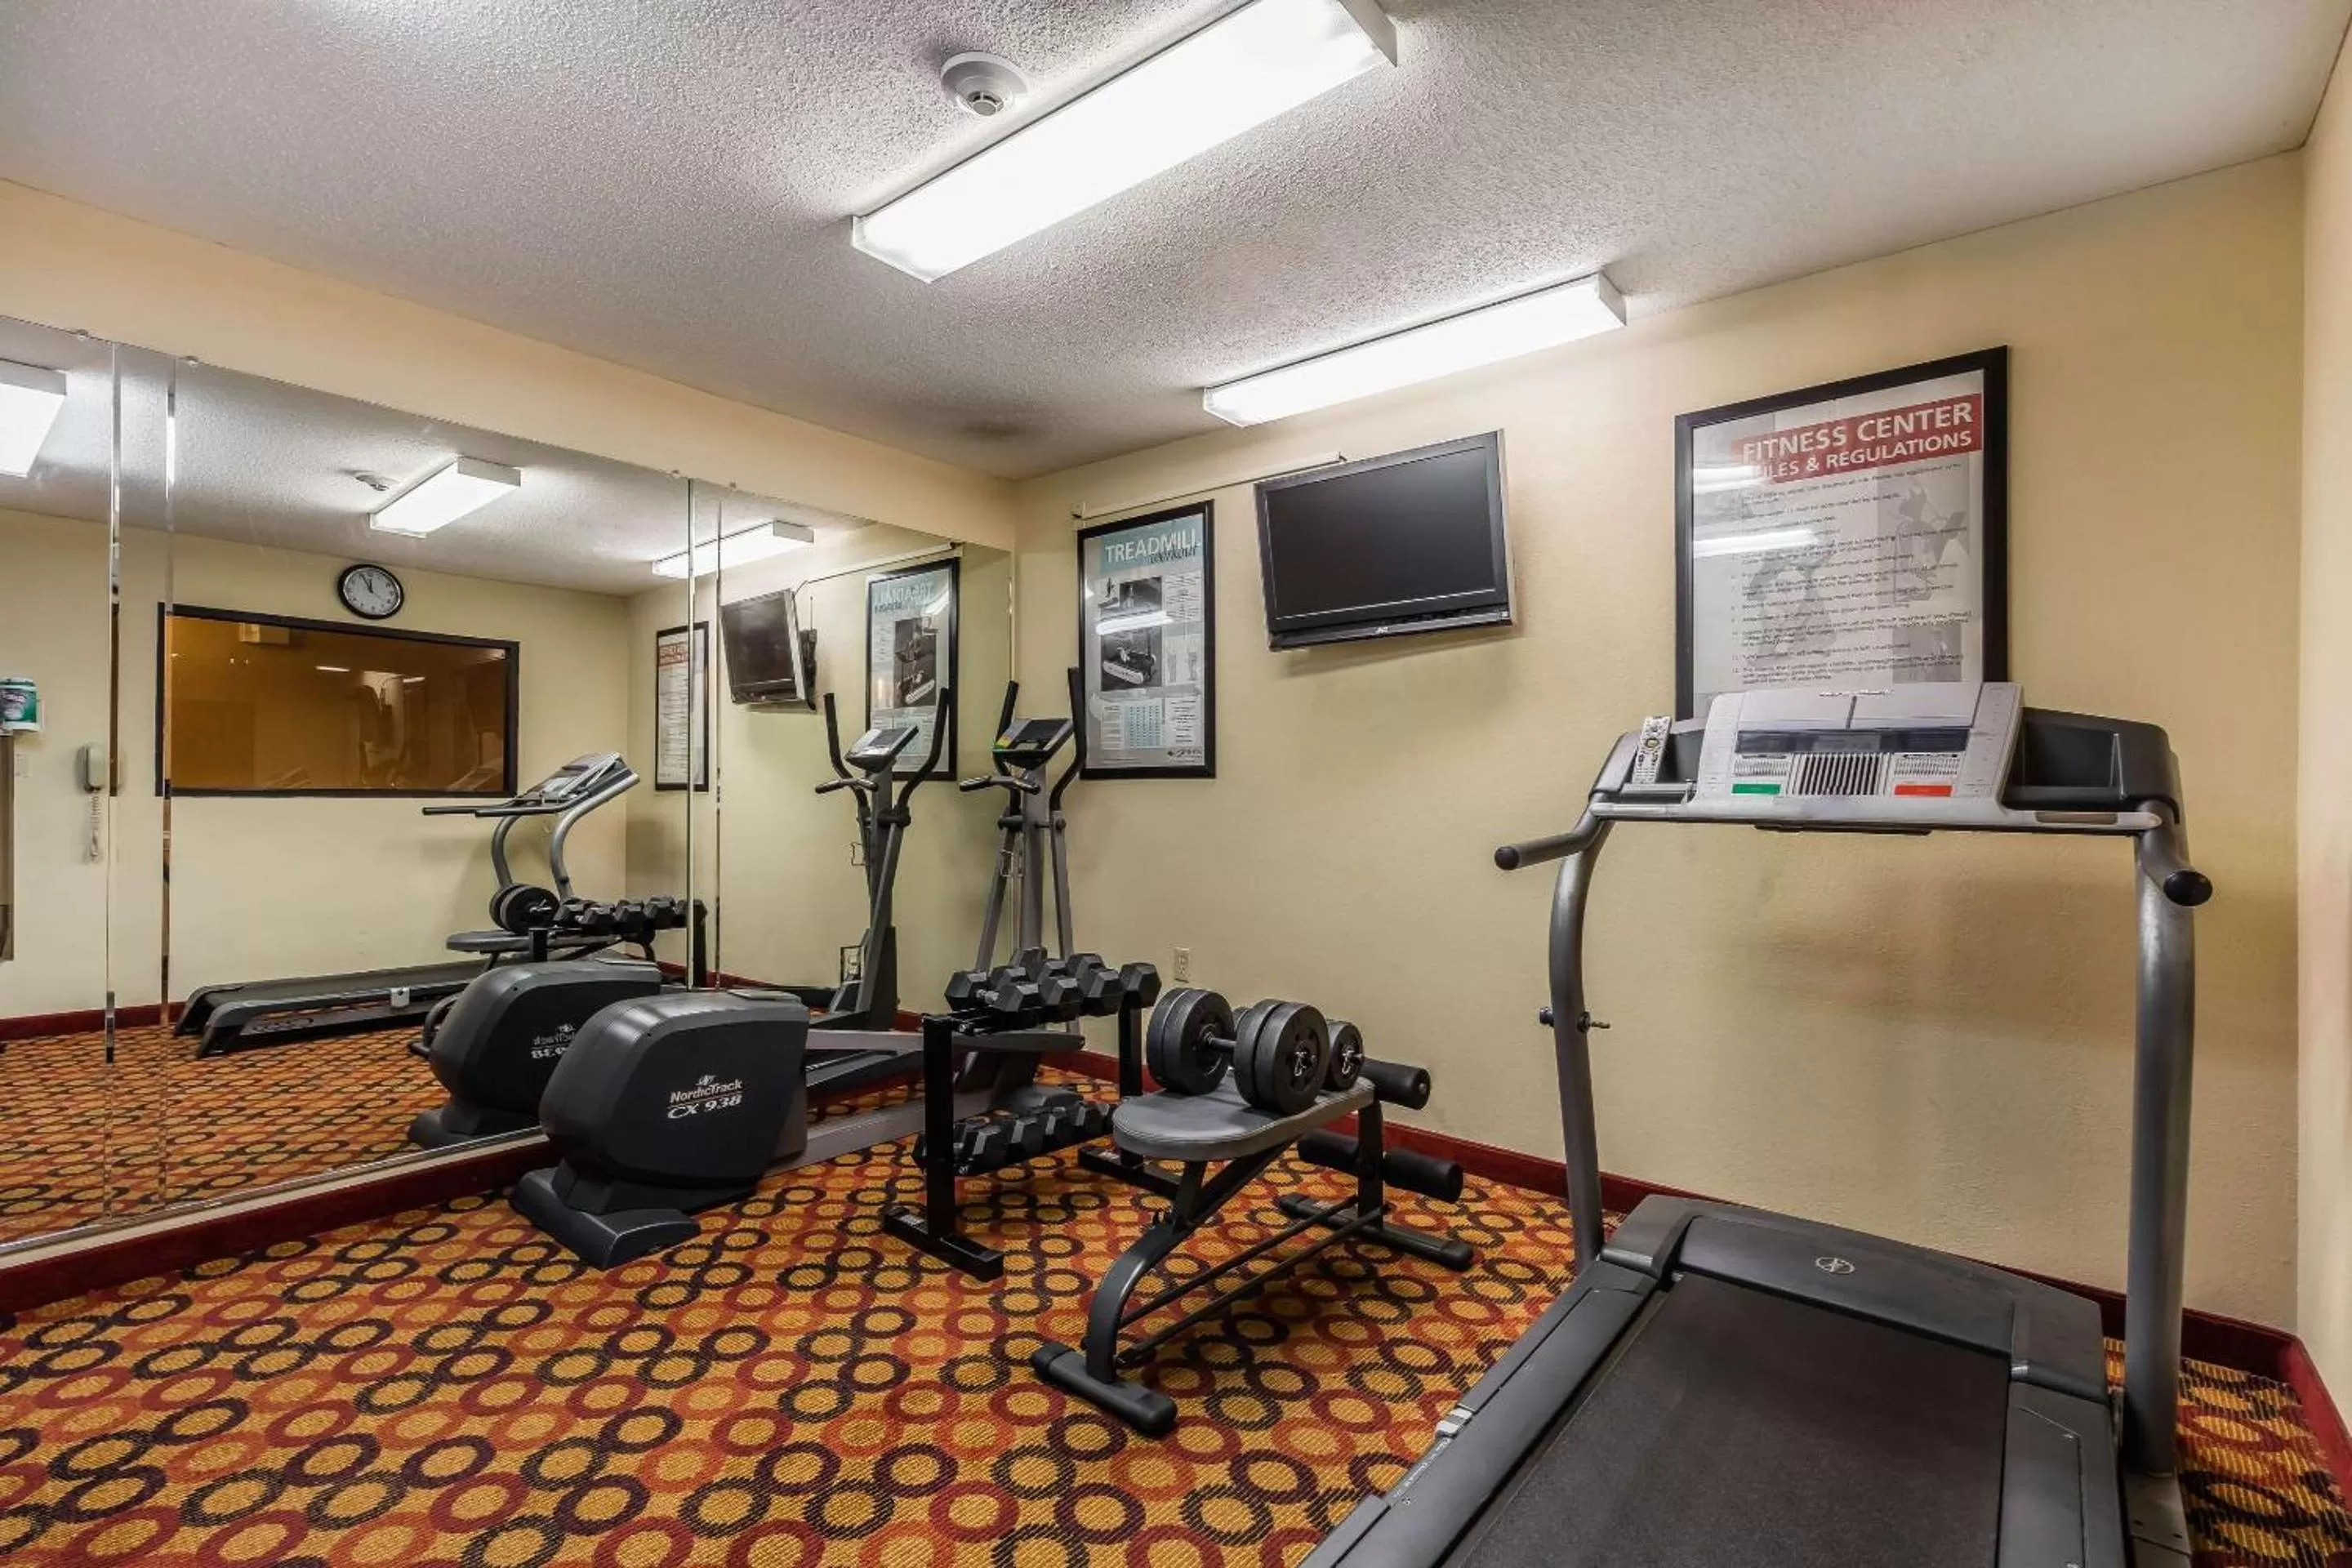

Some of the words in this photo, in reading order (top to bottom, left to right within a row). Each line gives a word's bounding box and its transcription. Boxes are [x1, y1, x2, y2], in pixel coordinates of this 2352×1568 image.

[1743, 425, 1847, 465] FITNESS
[1856, 402, 1974, 442] CENTER
[1806, 456, 1820, 472] &
[1826, 430, 1972, 468] REGULATIONS
[670, 1079, 743, 1104] NordicTrack
[667, 1102, 700, 1119] CX
